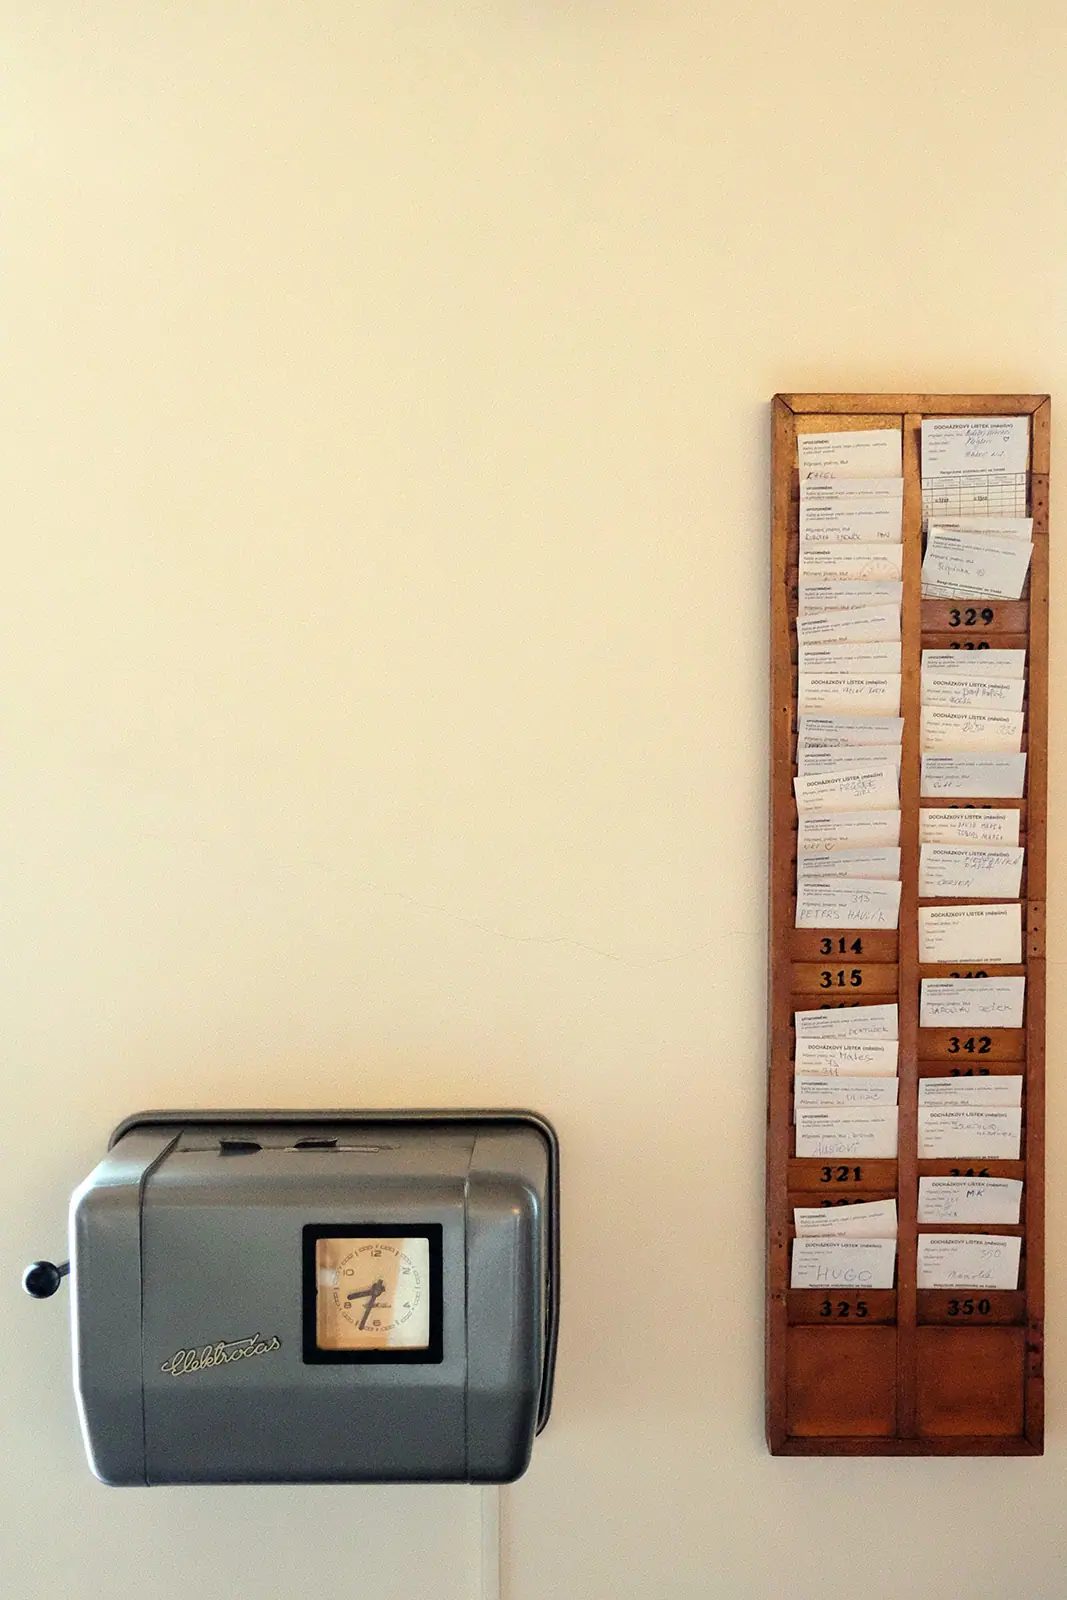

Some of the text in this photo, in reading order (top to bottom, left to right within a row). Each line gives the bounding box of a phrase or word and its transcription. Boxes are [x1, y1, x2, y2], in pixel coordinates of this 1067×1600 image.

[948, 608, 994, 627] 329
[820, 937, 863, 955] 314
[820, 969, 862, 988] 315
[948, 1036, 992, 1053] 342
[820, 1166, 862, 1182] 321
[343, 1268, 355, 1276] 10
[816, 1265, 872, 1281] HUGO
[820, 1300, 868, 1318] 325
[948, 1298, 991, 1316] 350
